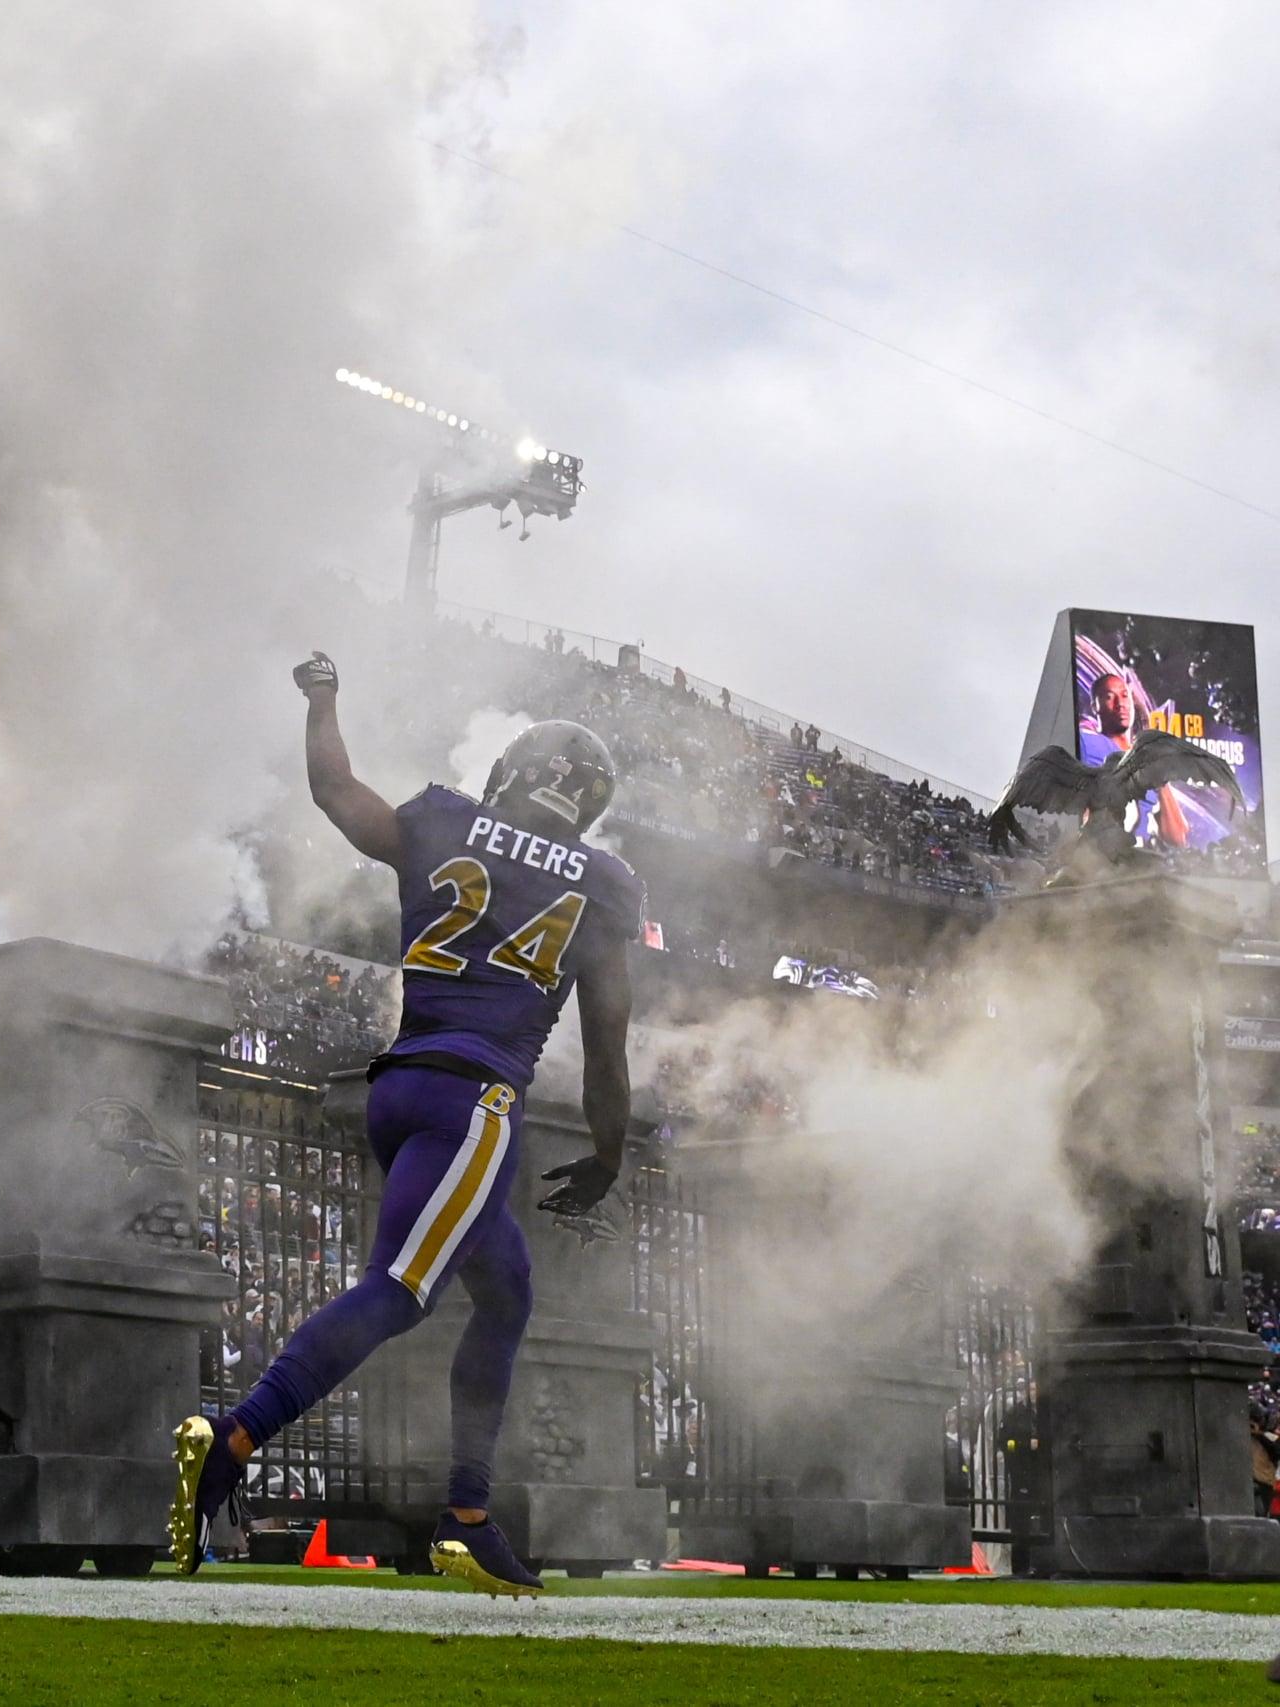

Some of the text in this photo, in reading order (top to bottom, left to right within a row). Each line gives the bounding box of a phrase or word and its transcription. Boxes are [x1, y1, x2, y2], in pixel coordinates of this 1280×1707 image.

[1184, 714, 1204, 738] CB
[549, 774, 563, 791] 2
[466, 816, 589, 881] PETERS
[402, 856, 588, 993] 24
[478, 1083, 516, 1115] B
